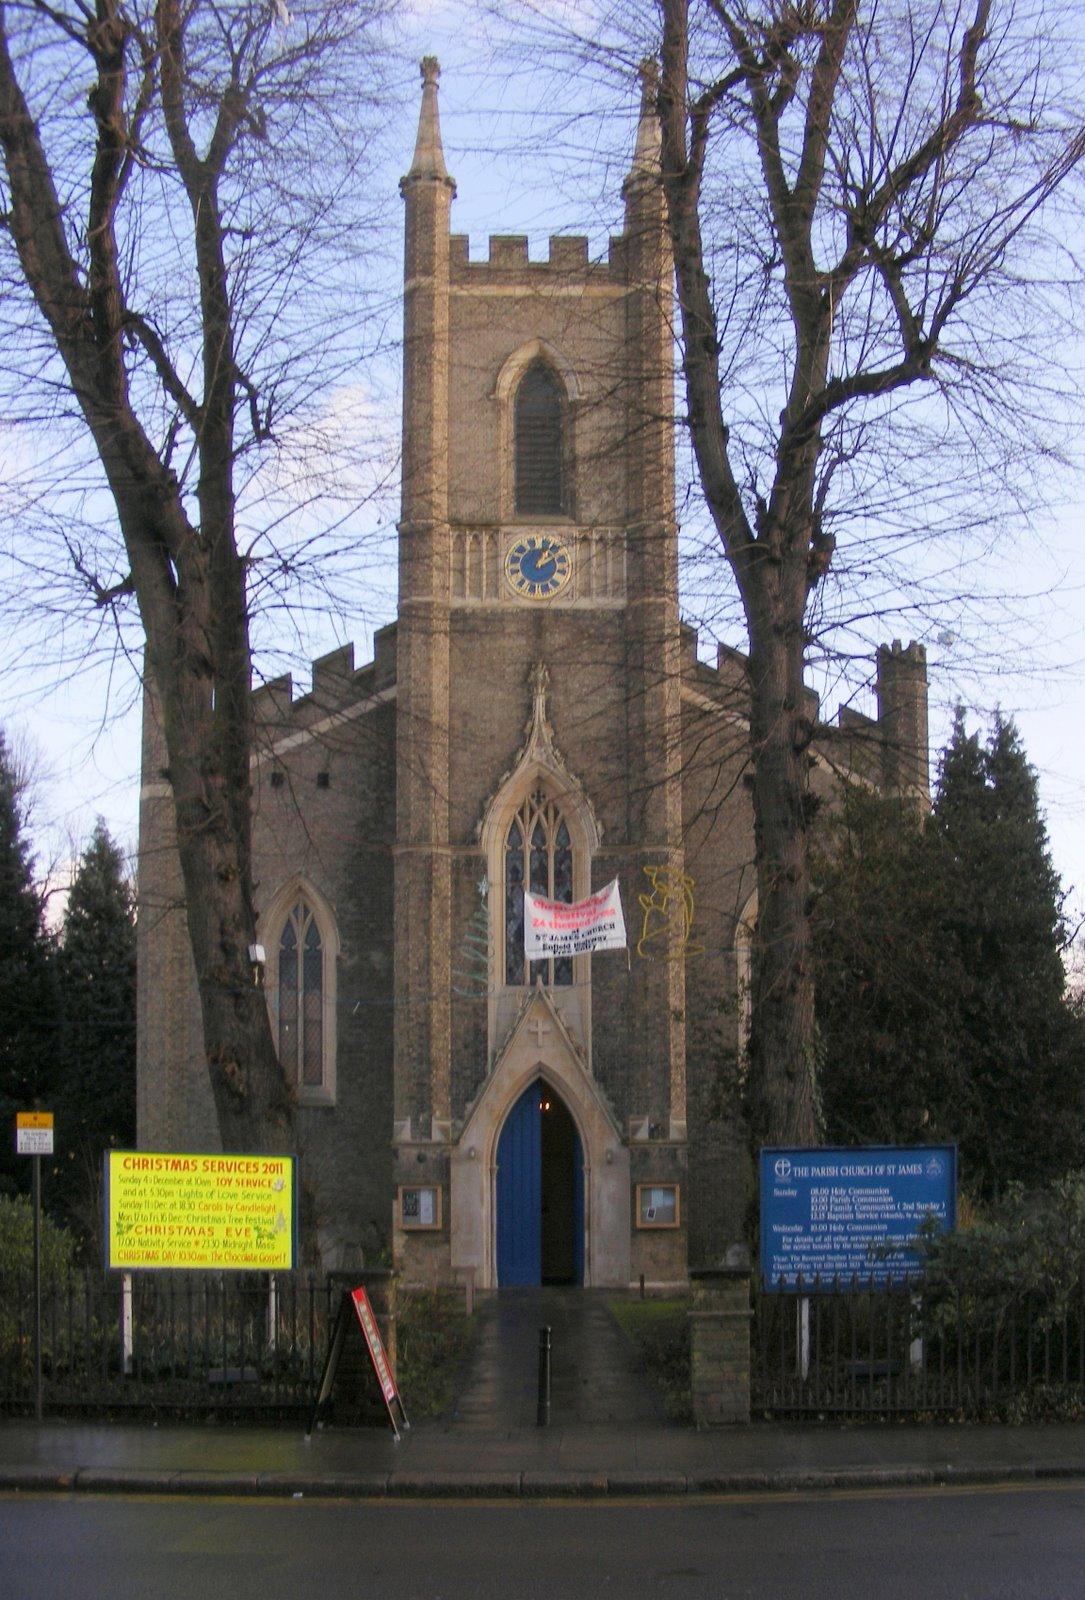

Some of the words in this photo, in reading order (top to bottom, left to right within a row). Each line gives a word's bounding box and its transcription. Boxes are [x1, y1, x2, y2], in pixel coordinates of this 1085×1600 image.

[554, 908, 597, 919] Festival
[549, 918, 591, 929] themed
[549, 934, 580, 942] JAMES
[581, 923, 615, 938] CHURCH
[542, 942, 571, 952] Enfield
[574, 936, 607, 949] Highway
[123, 1157, 198, 1172] CHRISTMAS
[202, 1160, 259, 1173] SERVICES
[262, 1162, 283, 1174] 2011
[793, 1166, 809, 1177] THE
[811, 1166, 838, 1177] PARISH
[840, 1164, 873, 1177] CHURCH
[874, 1164, 886, 1176] OF
[886, 1164, 896, 1175] ST
[898, 1164, 922, 1174] JAMES
[119, 1174, 140, 1185] Sunday
[154, 1176, 184, 1185] December
[216, 1178, 232, 1186] TOY
[236, 1179, 272, 1188] SERVICE
[123, 1188, 136, 1196] and
[138, 1188, 146, 1196] at
[180, 1189, 204, 1200] Lights
[206, 1190, 214, 1200] of
[218, 1190, 238, 1200] Love
[242, 1191, 272, 1200] Service
[774, 1188, 798, 1197] Sunday
[831, 1187, 846, 1196] Holy
[848, 1186, 890, 1196] Communion
[830, 1196, 850, 1204] Parish
[852, 1195, 894, 1203] Communion
[119, 1200, 142, 1210] Sunday
[154, 1201, 166, 1209] Dec
[170, 1202, 178, 1210] at
[198, 1202, 222, 1211] Carols
[226, 1203, 233, 1213] by
[236, 1203, 276, 1214] Candlelight
[830, 1204, 852, 1212] Family
[854, 1203, 896, 1212] Communion
[902, 1202, 914, 1210] 2nd
[118, 1212, 132, 1222] Mon
[186, 1214, 226, 1224] Christmas
[228, 1216, 244, 1224] Tree
[246, 1216, 274, 1226] Festival
[828, 1212, 854, 1221] Baptism
[855, 1211, 879, 1220] Service
[134, 1224, 214, 1237] CHRISTMAS
[226, 1227, 251, 1238] EVE
[772, 1224, 803, 1232] Wednesday
[830, 1223, 844, 1232] Holy
[847, 1222, 888, 1232] Communion
[850, 1234, 872, 1242] services
[138, 1239, 164, 1248] Nativity
[167, 1239, 192, 1248] Service
[222, 1240, 252, 1250] Midnight
[256, 1240, 276, 1250] Mass
[834, 1242, 840, 1250] by
[842, 1242, 852, 1250] the
[118, 1250, 159, 1261] CHRISTMAS
[162, 1250, 176, 1261] DAY
[212, 1252, 223, 1262] The
[224, 1251, 258, 1262] Chocolate
